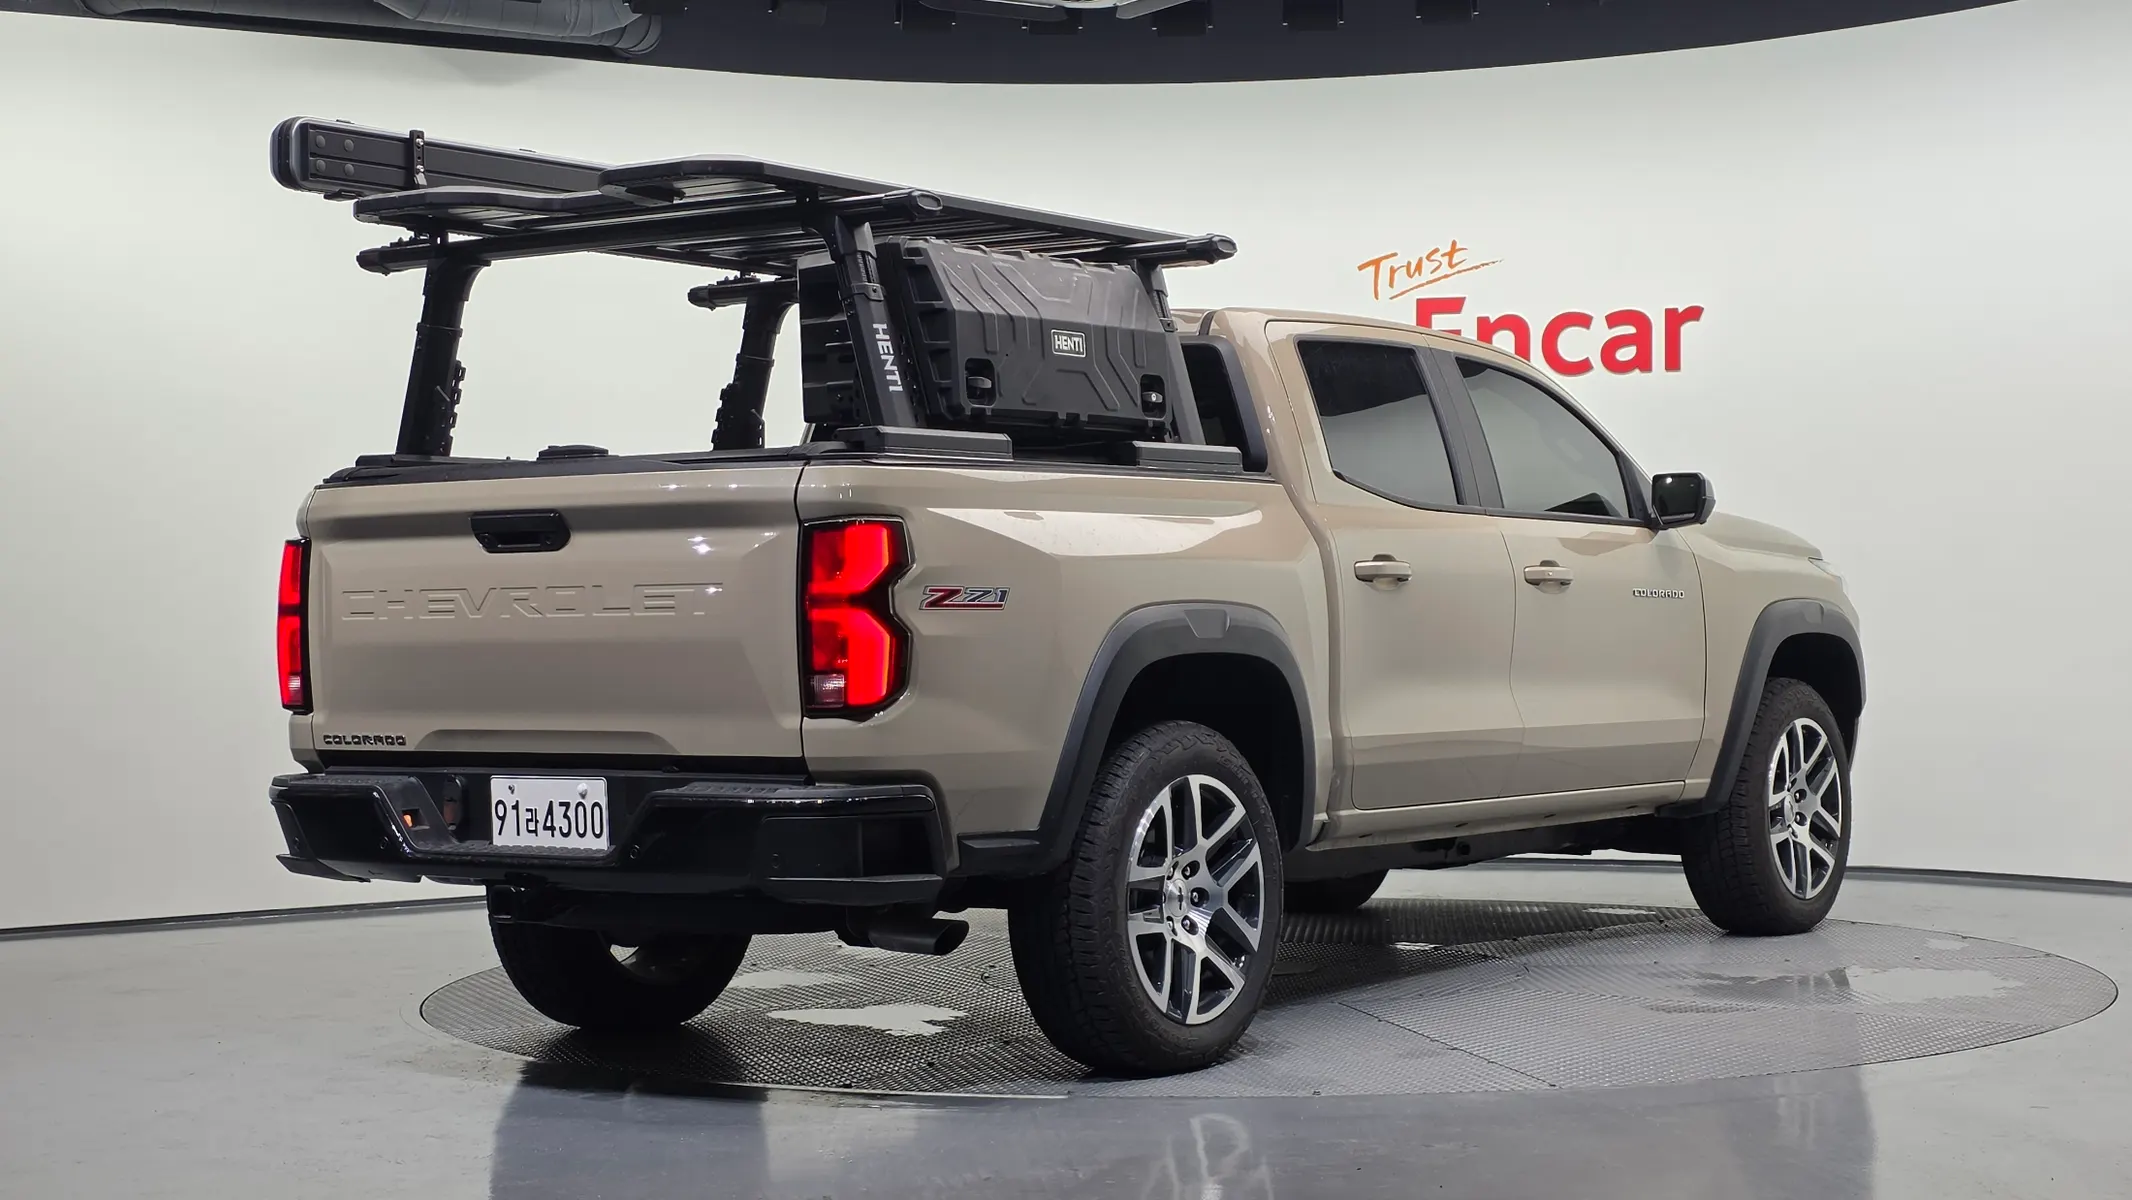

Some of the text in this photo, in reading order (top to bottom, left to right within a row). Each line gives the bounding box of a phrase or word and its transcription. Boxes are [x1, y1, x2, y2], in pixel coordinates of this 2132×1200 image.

[1357, 239, 1468, 300] Trust
[1054, 334, 1083, 352] HENTI
[873, 323, 904, 392] HENTI
[342, 582, 724, 621] CHEVROLET
[920, 586, 1010, 610] Z71
[1632, 587, 1686, 600] COLORADO
[322, 733, 407, 747] COLORADO
